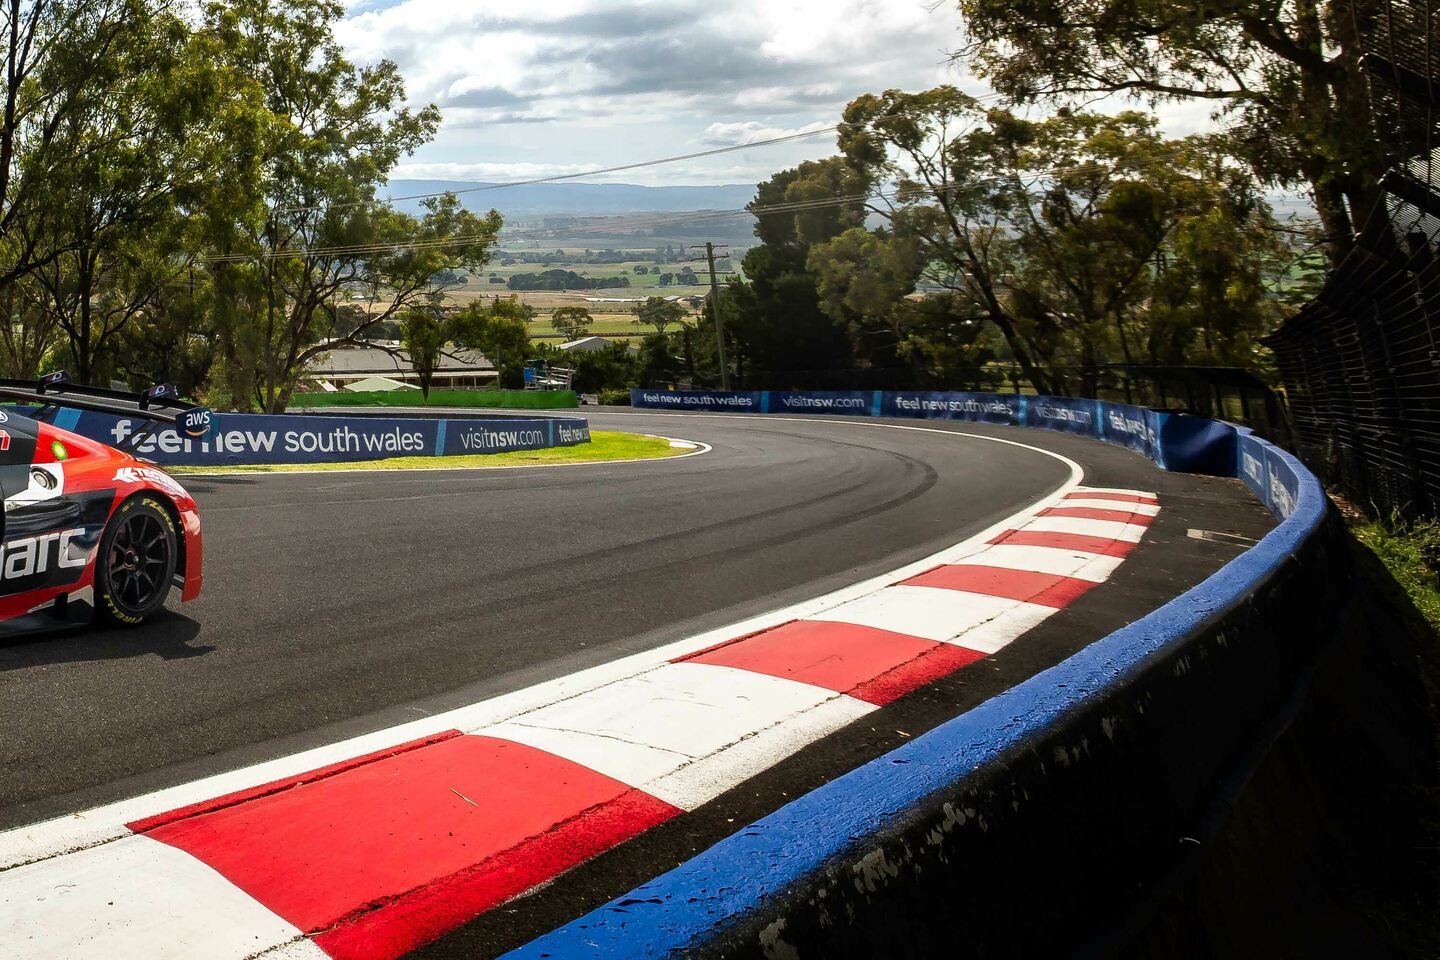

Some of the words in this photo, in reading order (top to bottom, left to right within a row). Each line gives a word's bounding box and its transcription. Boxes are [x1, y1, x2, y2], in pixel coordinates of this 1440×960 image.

[643, 393, 660, 403] feel
[661, 395, 681, 404] new
[684, 394, 716, 405] south
[716, 395, 753, 406] wales
[783, 395, 865, 408] visitnsw.com
[895, 397, 921, 410] feel
[922, 400, 948, 411] new
[949, 399, 981, 412] south
[981, 400, 1014, 415] wales
[186, 411, 210, 427] aws
[285, 426, 360, 452] south
[363, 426, 424, 452] wales
[461, 426, 544, 449] visitnsw.com
[558, 424, 572, 442] feel
